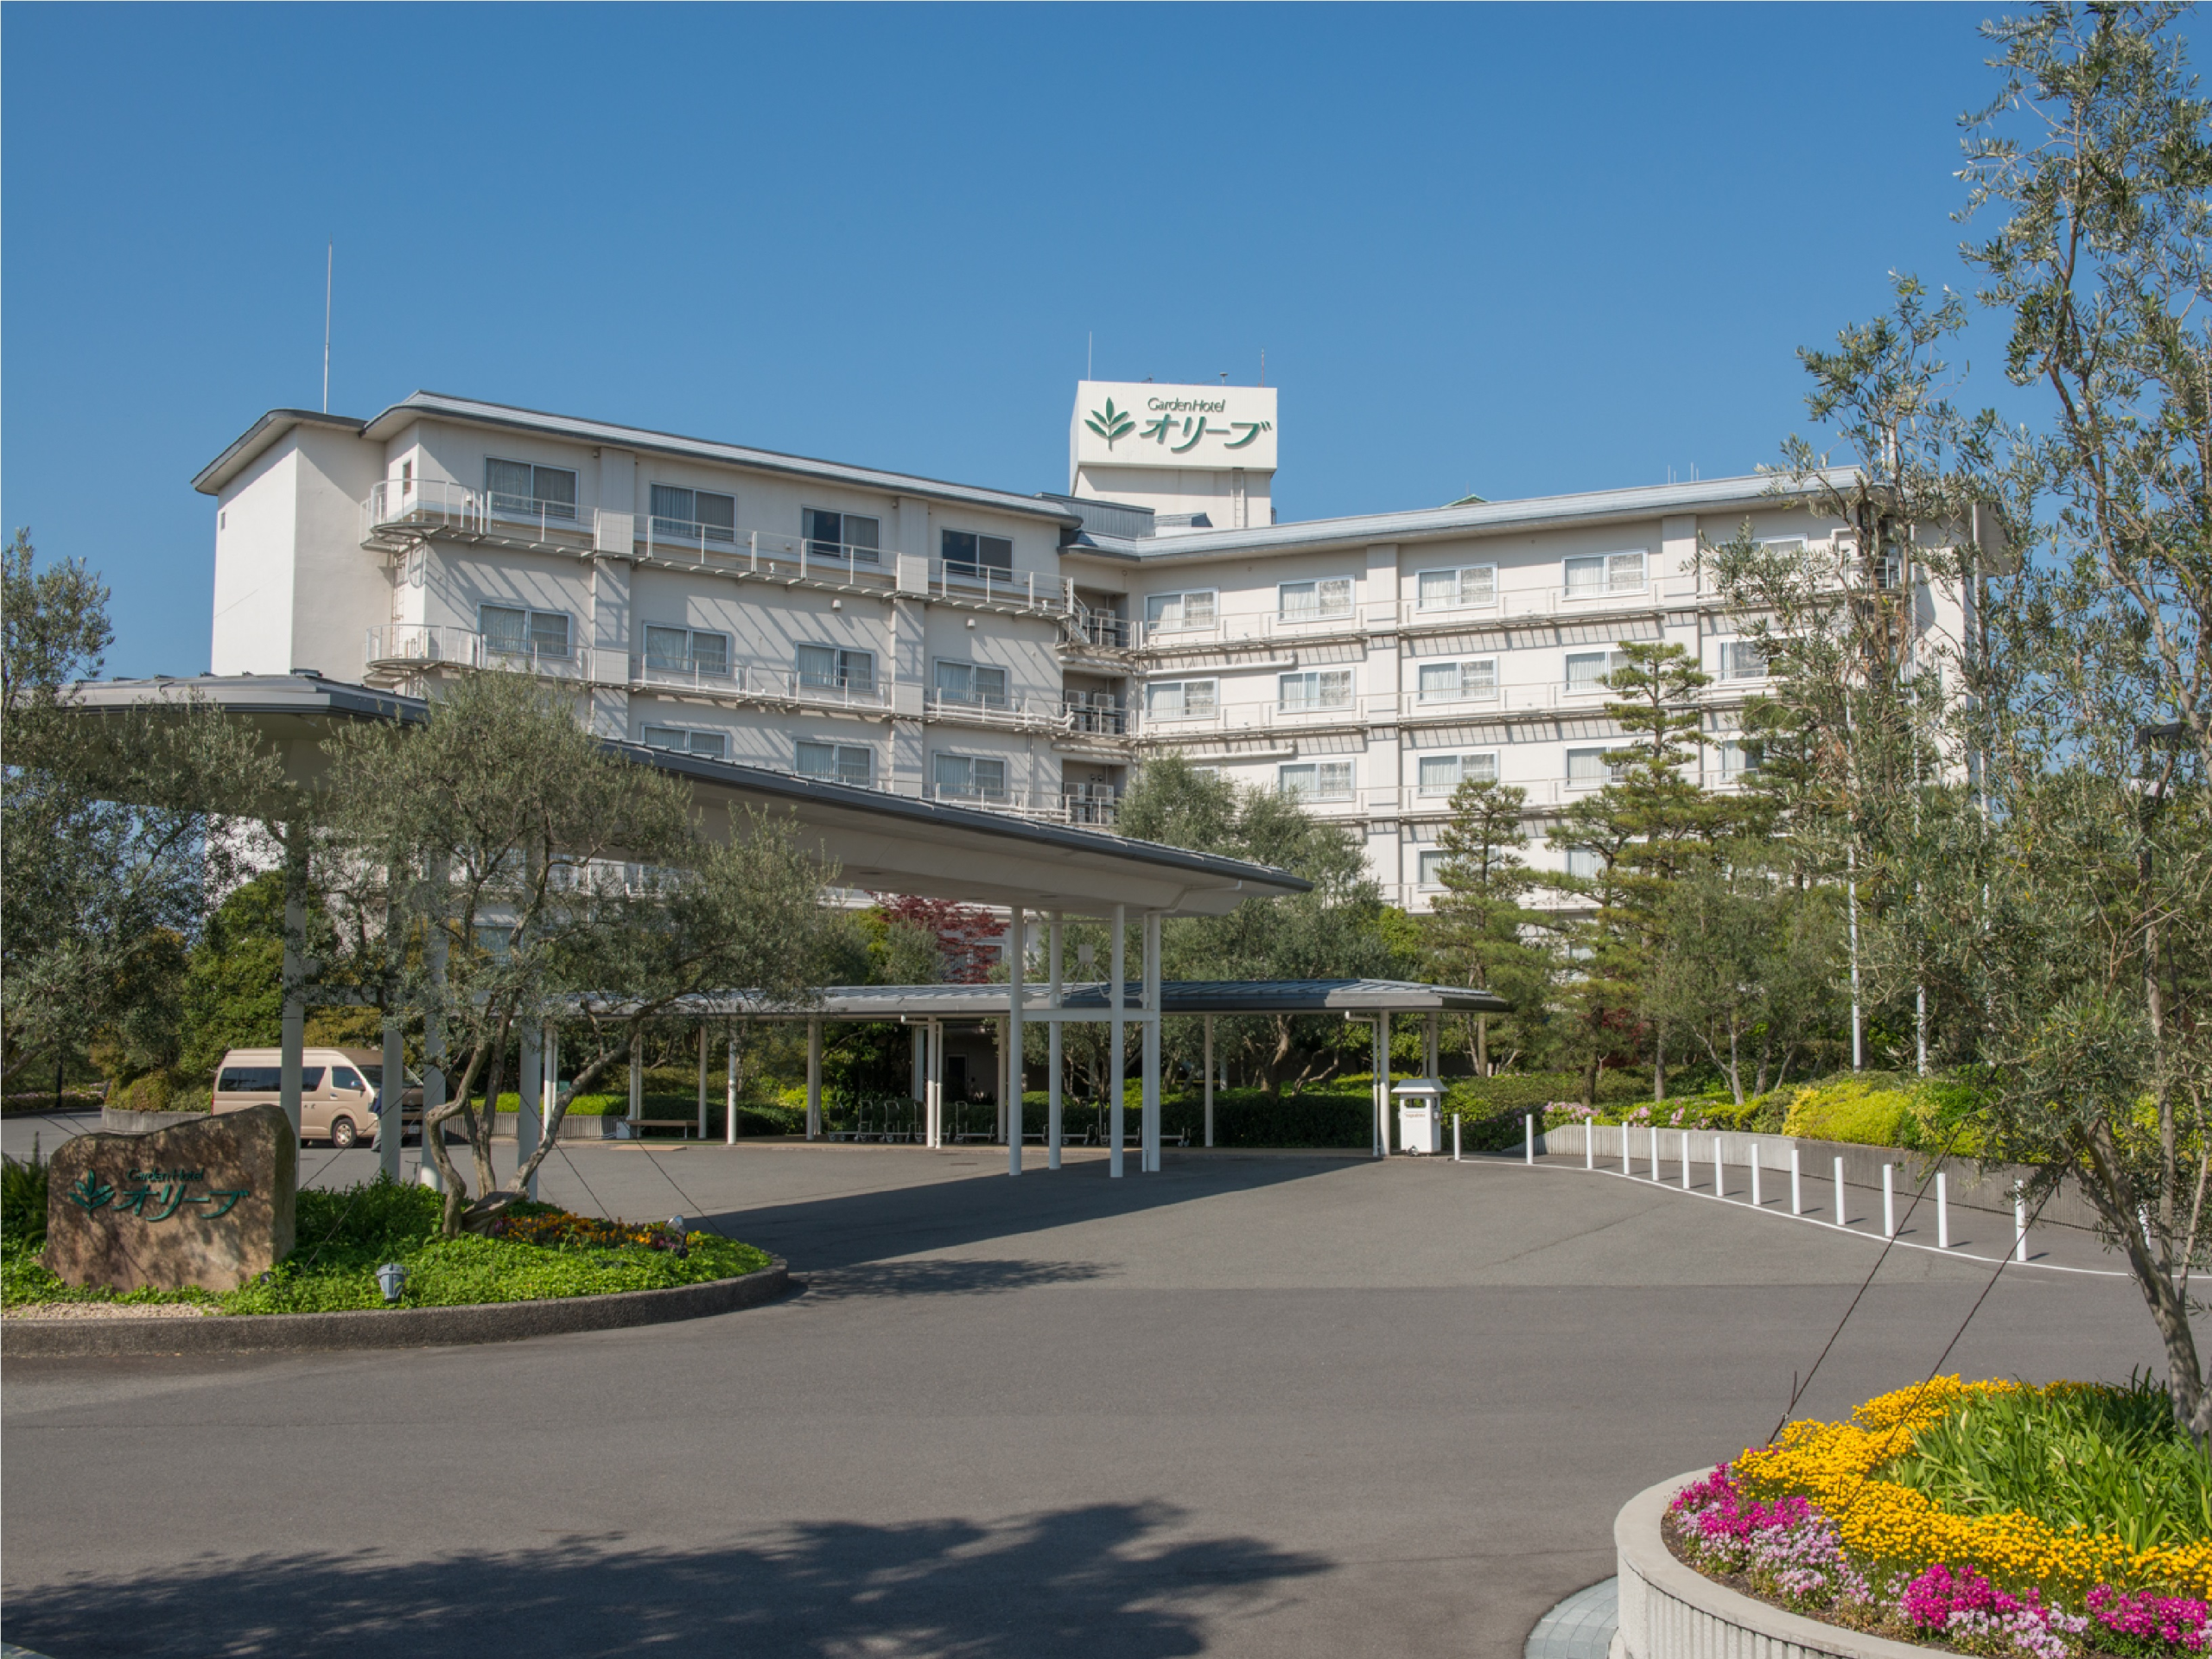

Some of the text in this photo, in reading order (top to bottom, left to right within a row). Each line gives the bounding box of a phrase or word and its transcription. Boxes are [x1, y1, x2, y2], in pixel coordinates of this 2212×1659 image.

[1147, 397, 1225, 412] Garden Hotel
[1139, 414, 1272, 453] オリーブ
[127, 1167, 204, 1181] Garden Hotel
[112, 1184, 249, 1222] オリーブ
